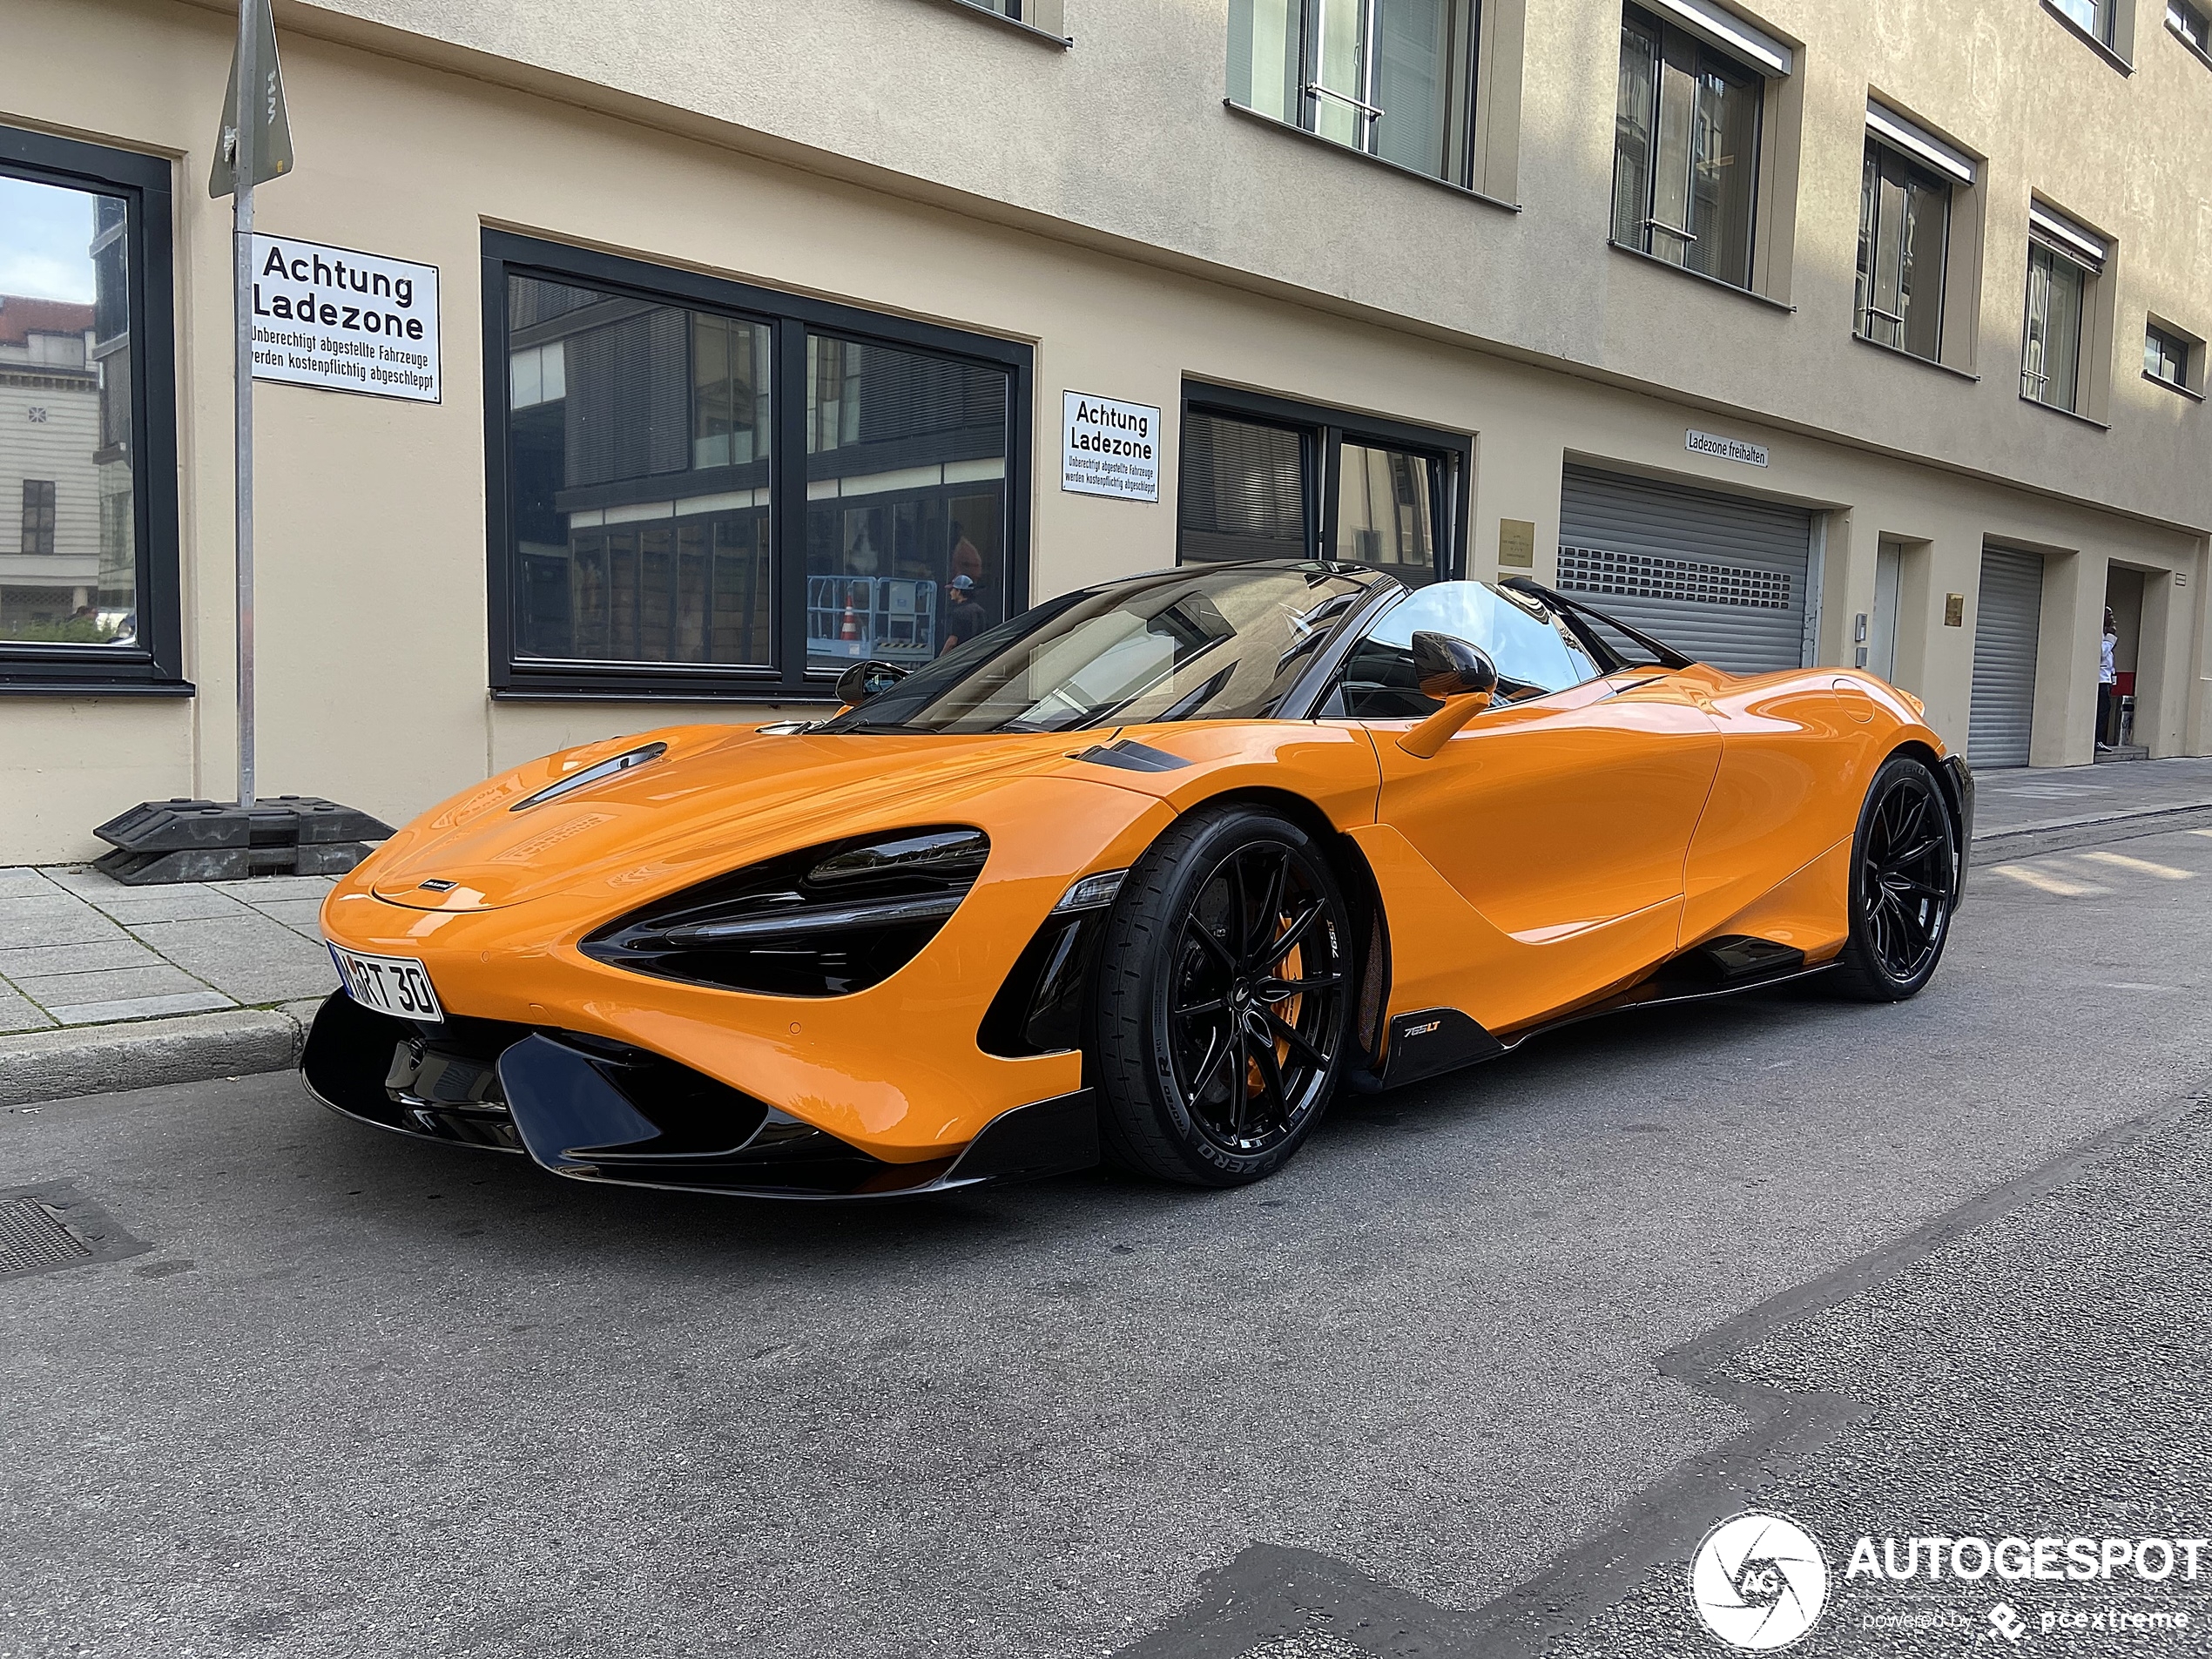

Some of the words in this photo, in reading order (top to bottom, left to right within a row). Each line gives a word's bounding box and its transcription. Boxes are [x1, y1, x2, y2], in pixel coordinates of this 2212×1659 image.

[263, 246, 413, 307] Achtung
[253, 284, 423, 340] Ladezone
[252, 325, 316, 353] Unberechtigt
[320, 337, 374, 359] abgestellte
[380, 345, 428, 369] Fahrzeuge
[252, 349, 284, 367] erden
[289, 353, 366, 381] kostenpflichtig
[371, 368, 434, 391] abgeschleppt
[1076, 401, 1148, 438] Achtung
[1071, 427, 1151, 460] Ladezone
[1689, 433, 1727, 455] Ladezone
[1729, 442, 1765, 464] freihalten
[1065, 472, 1084, 482] werden
[1087, 473, 1123, 490] kostenpflichtig
[1124, 479, 1156, 495] abgeschleppt
[1069, 455, 1101, 472] Unberechtigt
[1102, 461, 1128, 474] abgestellte
[1130, 464, 1153, 480] Fahrzeuge
[1325, 919, 1339, 958] 765LT
[388, 966, 434, 1013] 30
[1403, 1021, 1441, 1038] 765LT
[1163, 1085, 1186, 1135] TROFEO
